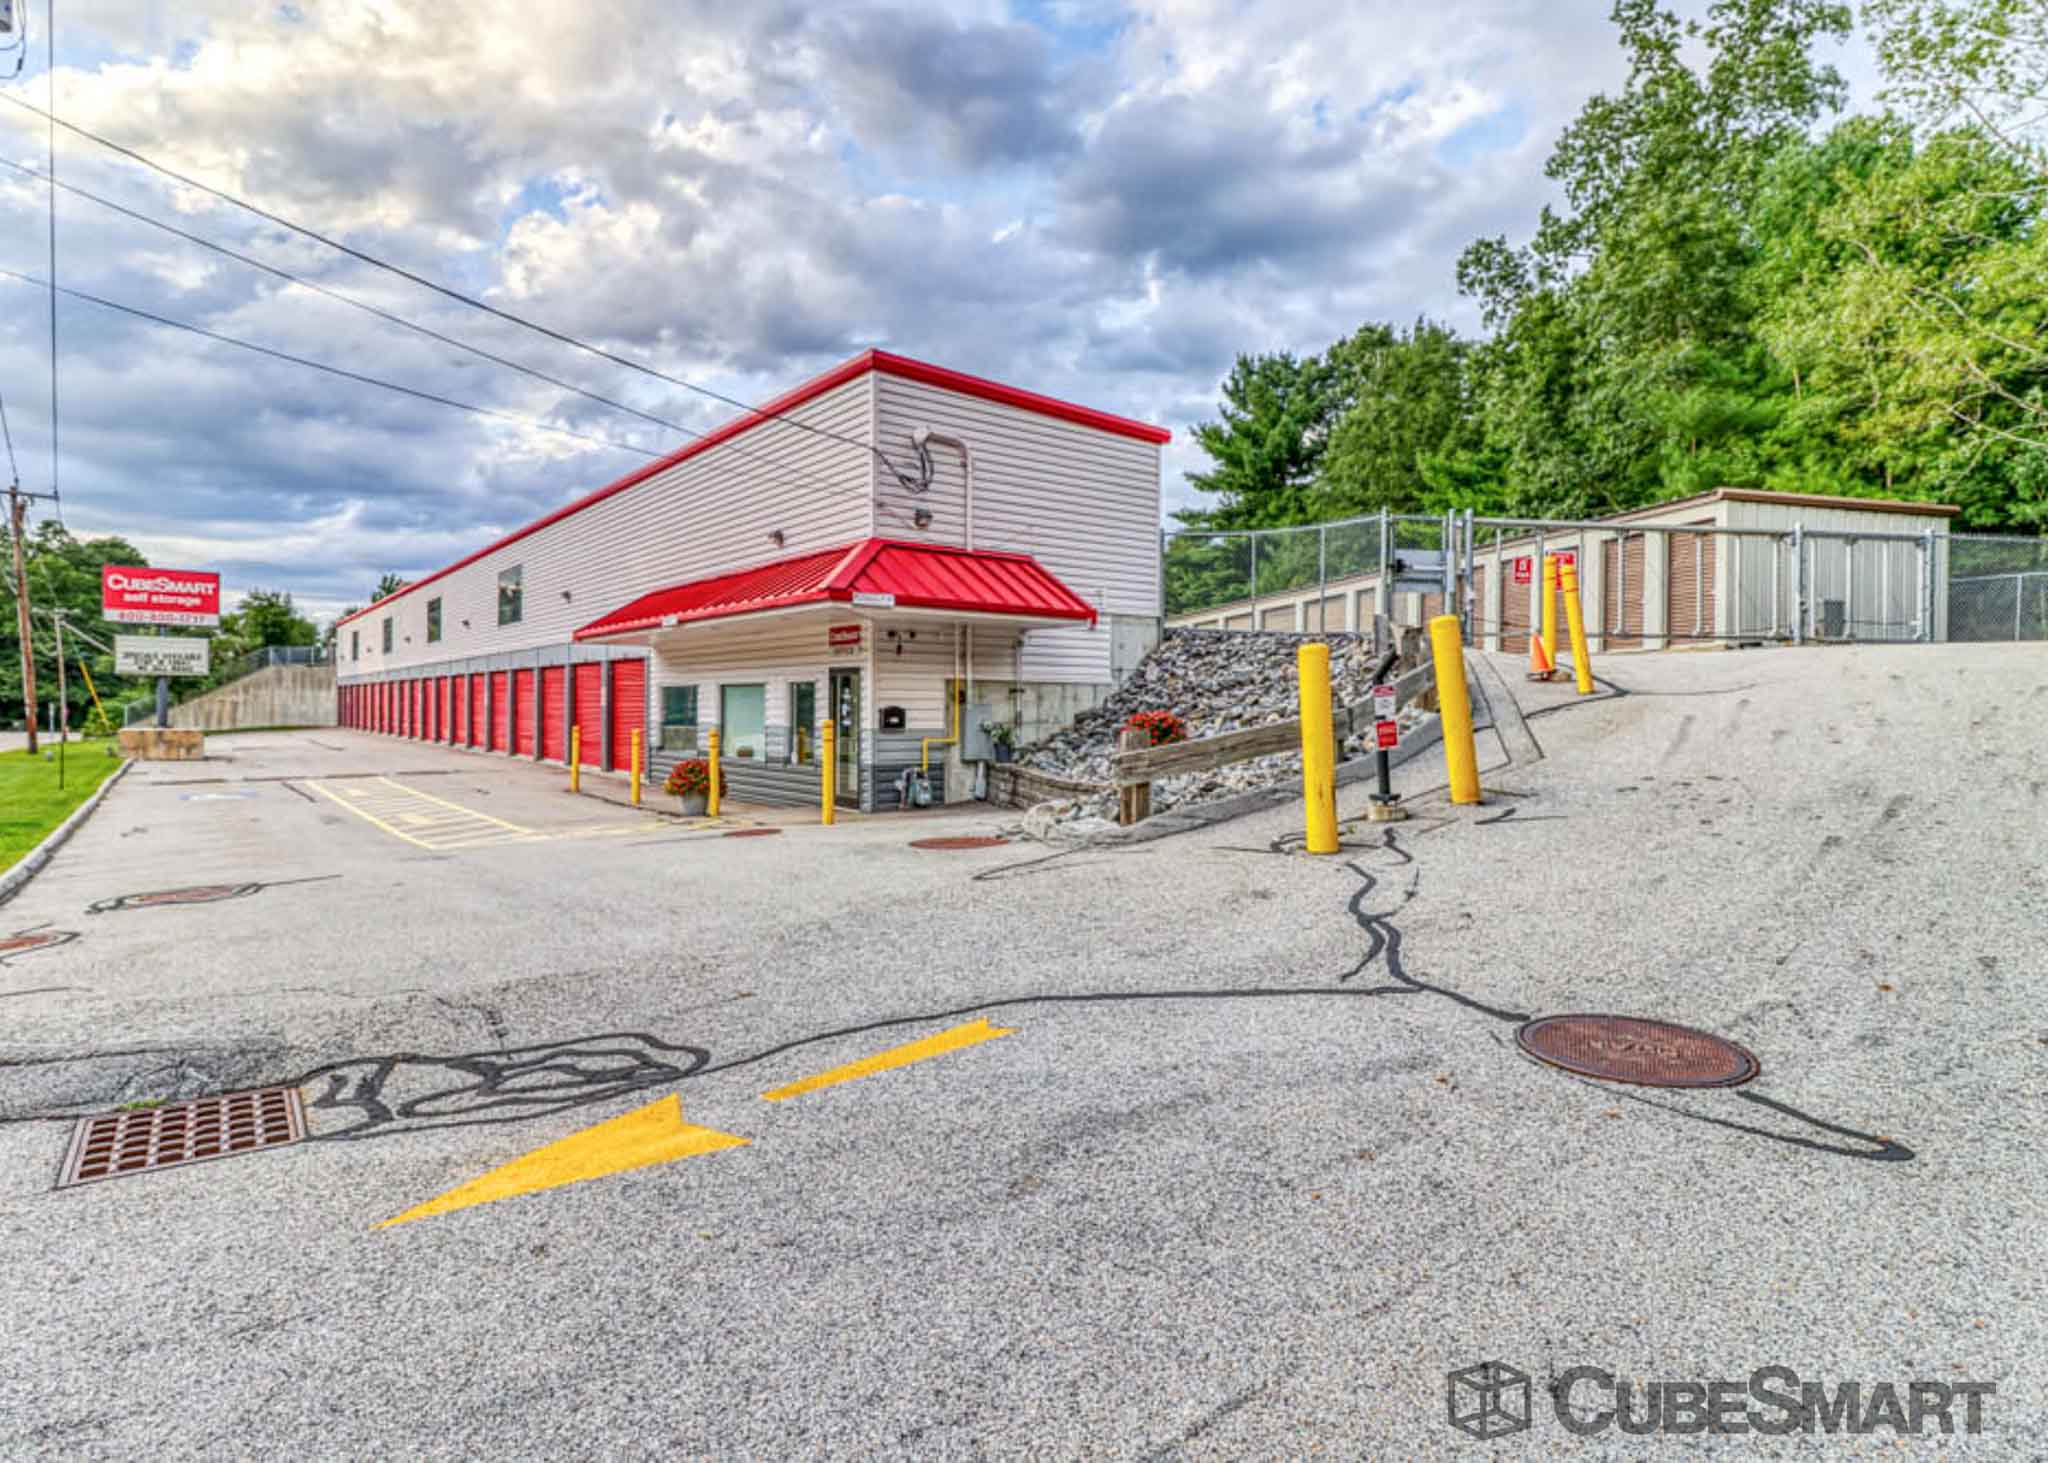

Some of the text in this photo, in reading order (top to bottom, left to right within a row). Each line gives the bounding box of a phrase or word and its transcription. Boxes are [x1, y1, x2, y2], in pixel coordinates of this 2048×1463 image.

[107, 573, 215, 597] CUBESMART
[123, 591, 203, 607] self storage
